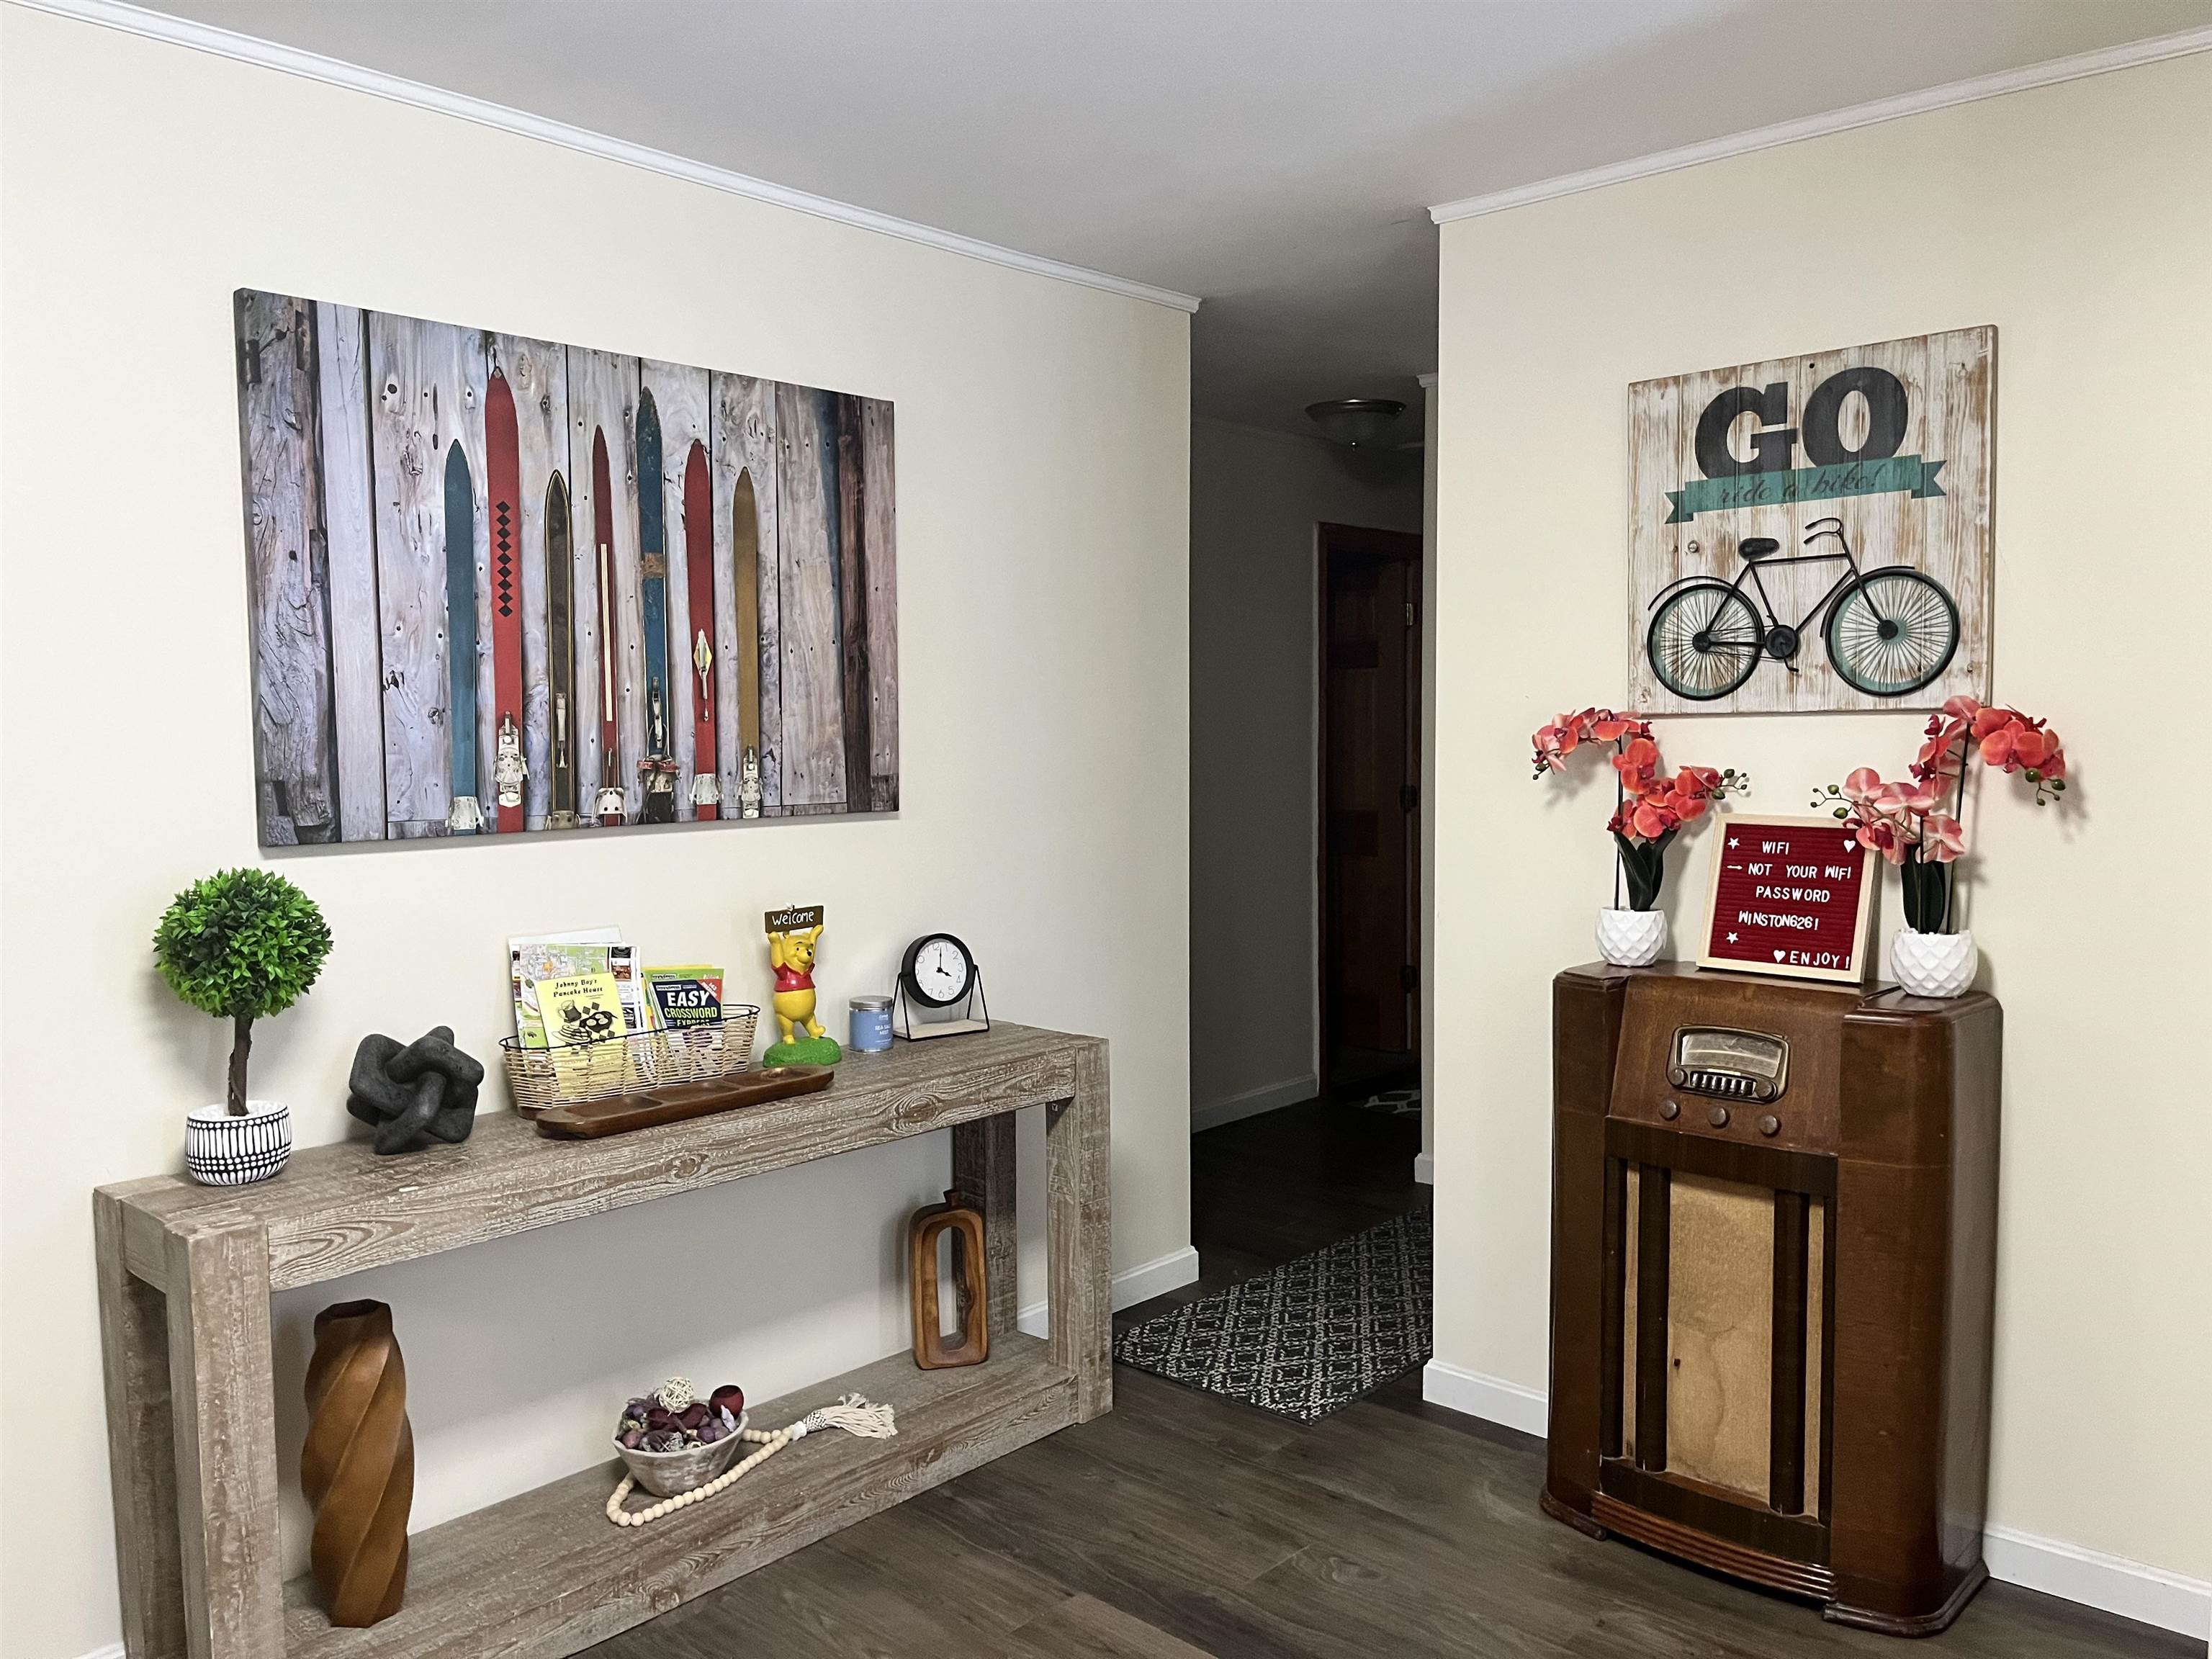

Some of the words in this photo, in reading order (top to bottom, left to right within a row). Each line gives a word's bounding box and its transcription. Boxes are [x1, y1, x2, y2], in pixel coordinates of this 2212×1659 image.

[1694, 367, 1909, 480] GO
[1719, 479, 1771, 503] ride
[1782, 483, 1798, 502] a
[1811, 461, 1888, 494] bike!
[1762, 840, 1789, 855] WIFI
[1748, 863, 1773, 876] NOT
[1786, 864, 1818, 879] YOUR
[1824, 864, 1852, 881] WIFI
[1755, 885, 1831, 903] PASSWORD
[771, 911, 814, 925] Welcome
[553, 988, 581, 997] Pancake
[667, 989, 710, 1007] EASY
[664, 1007, 718, 1019] CROSSWORD
